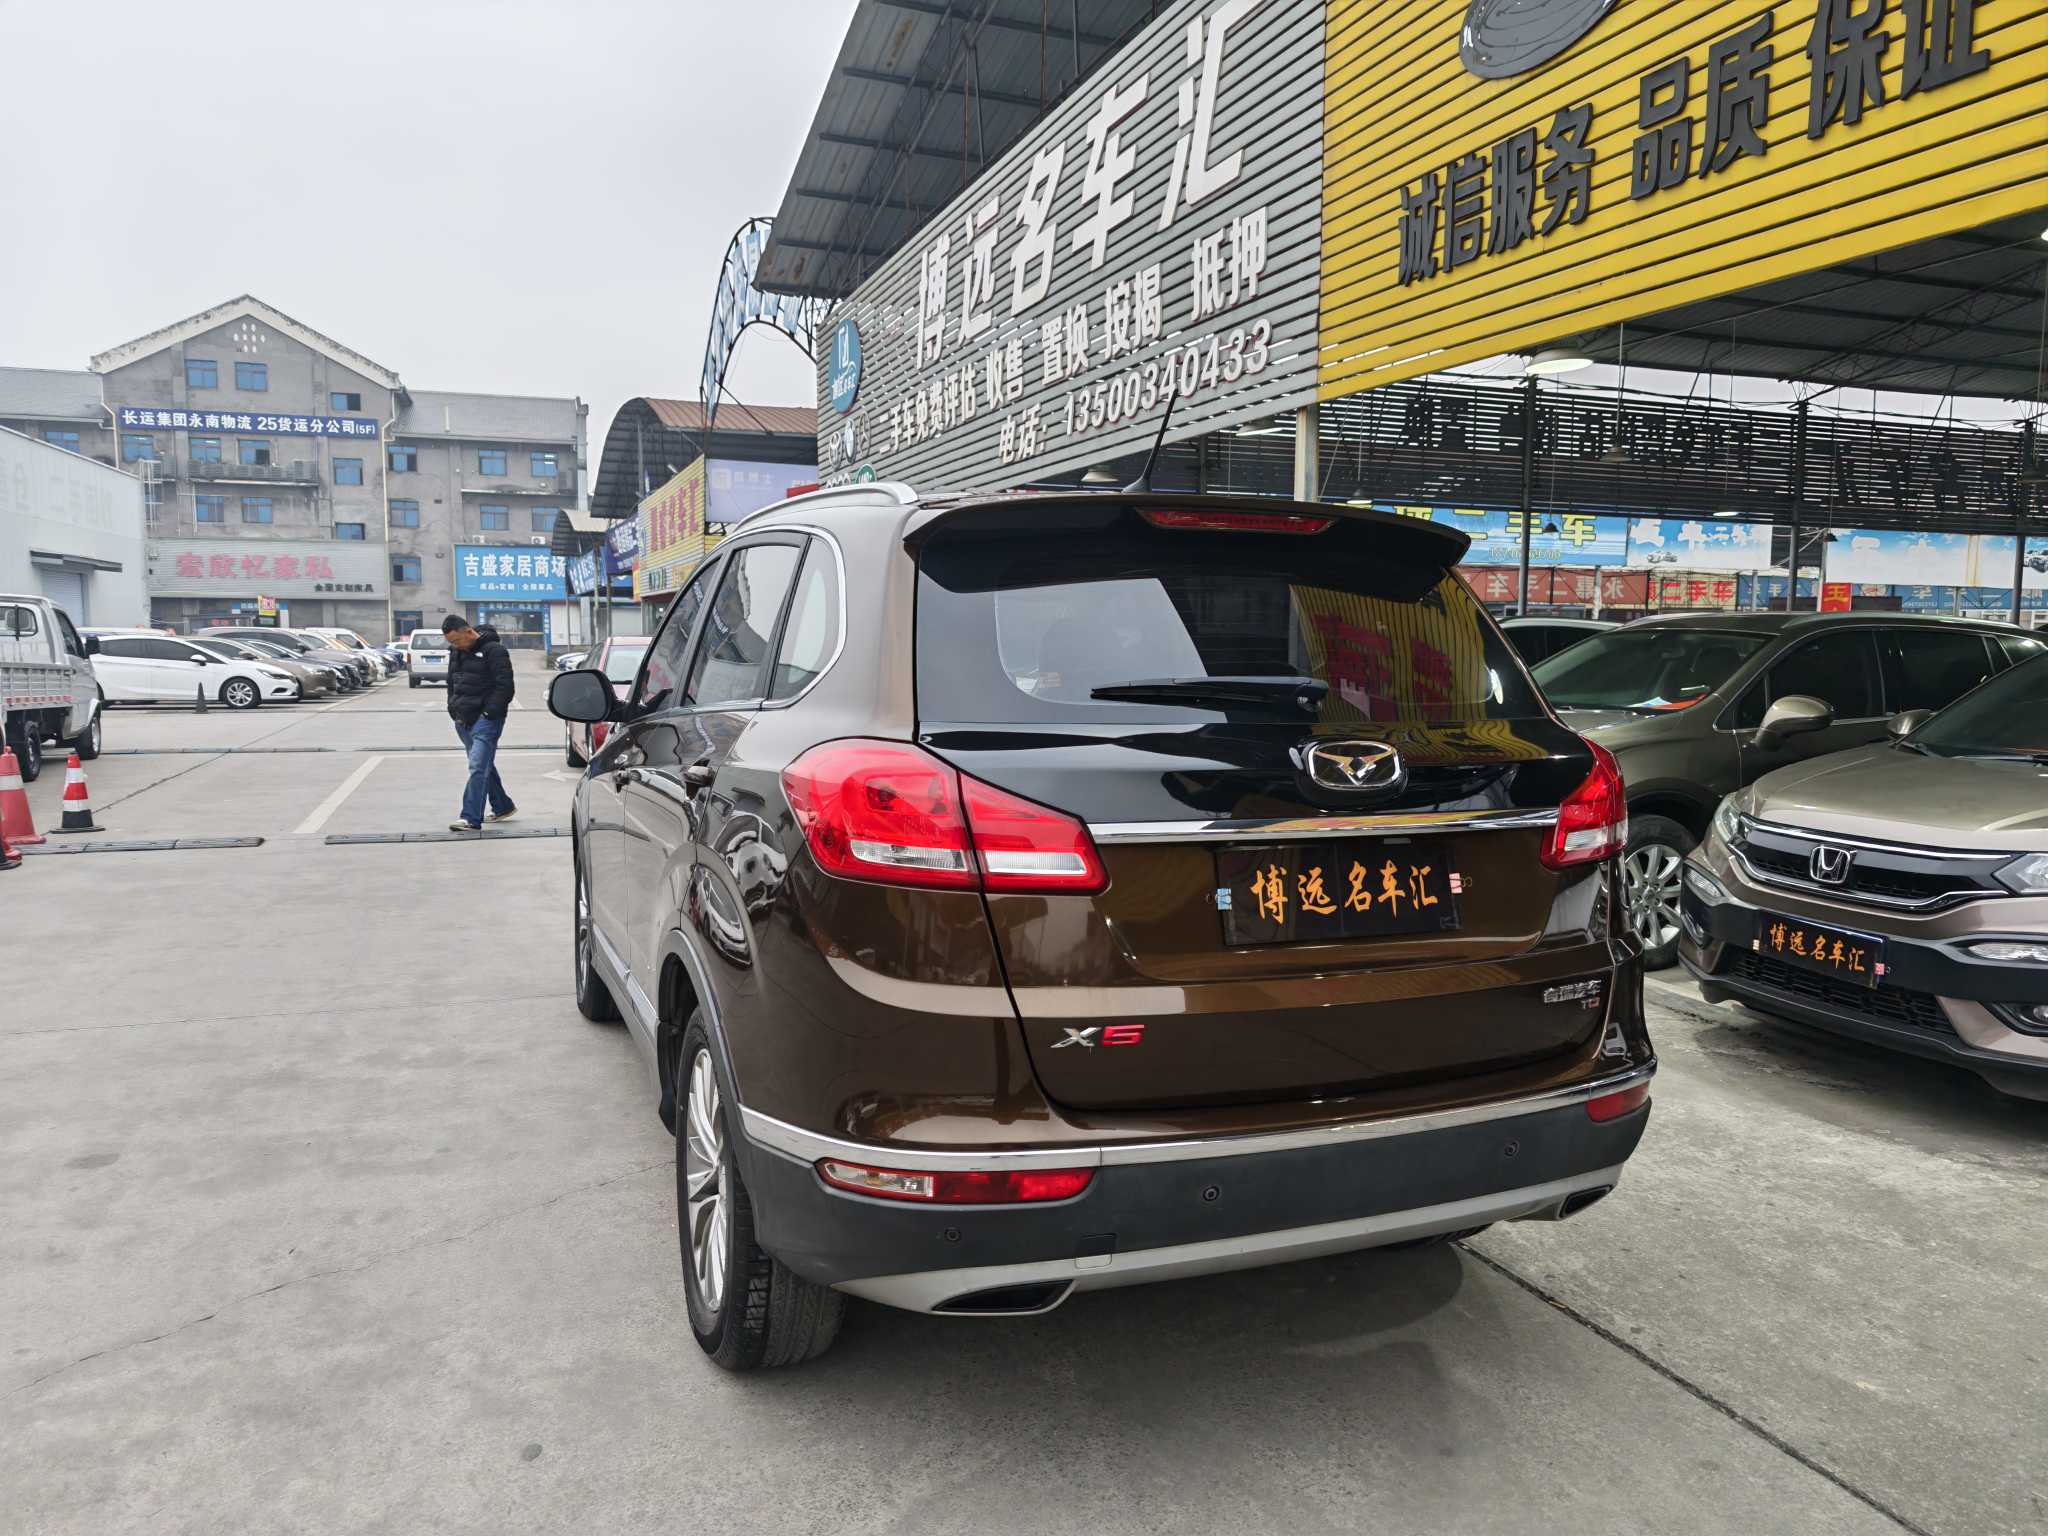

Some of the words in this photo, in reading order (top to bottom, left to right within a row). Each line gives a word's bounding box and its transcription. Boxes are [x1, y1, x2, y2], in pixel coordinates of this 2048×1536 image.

[1398, 102, 1596, 288] 诚信服务
[1631, 11, 1775, 200] 品质
[1806, 0, 1992, 140] 保证
[917, 0, 1262, 371] 博远名车汇
[879, 362, 978, 455] 二手车免费评估
[986, 338, 1024, 411] 收售
[1042, 303, 1090, 386] 置换
[1104, 263, 1163, 360] 按揭
[1191, 206, 1268, 321] 抵押
[1063, 318, 1273, 436] 13500340433
[122, 409, 252, 431] 长运集团永南物流
[1393, 505, 1598, 548] 二手车
[463, 553, 567, 578] 吉盛家居商场
[1250, 859, 1439, 925] 博远名车汇
[1769, 923, 1866, 973] 博远名车汇
[1050, 1024, 1146, 1049] X5
